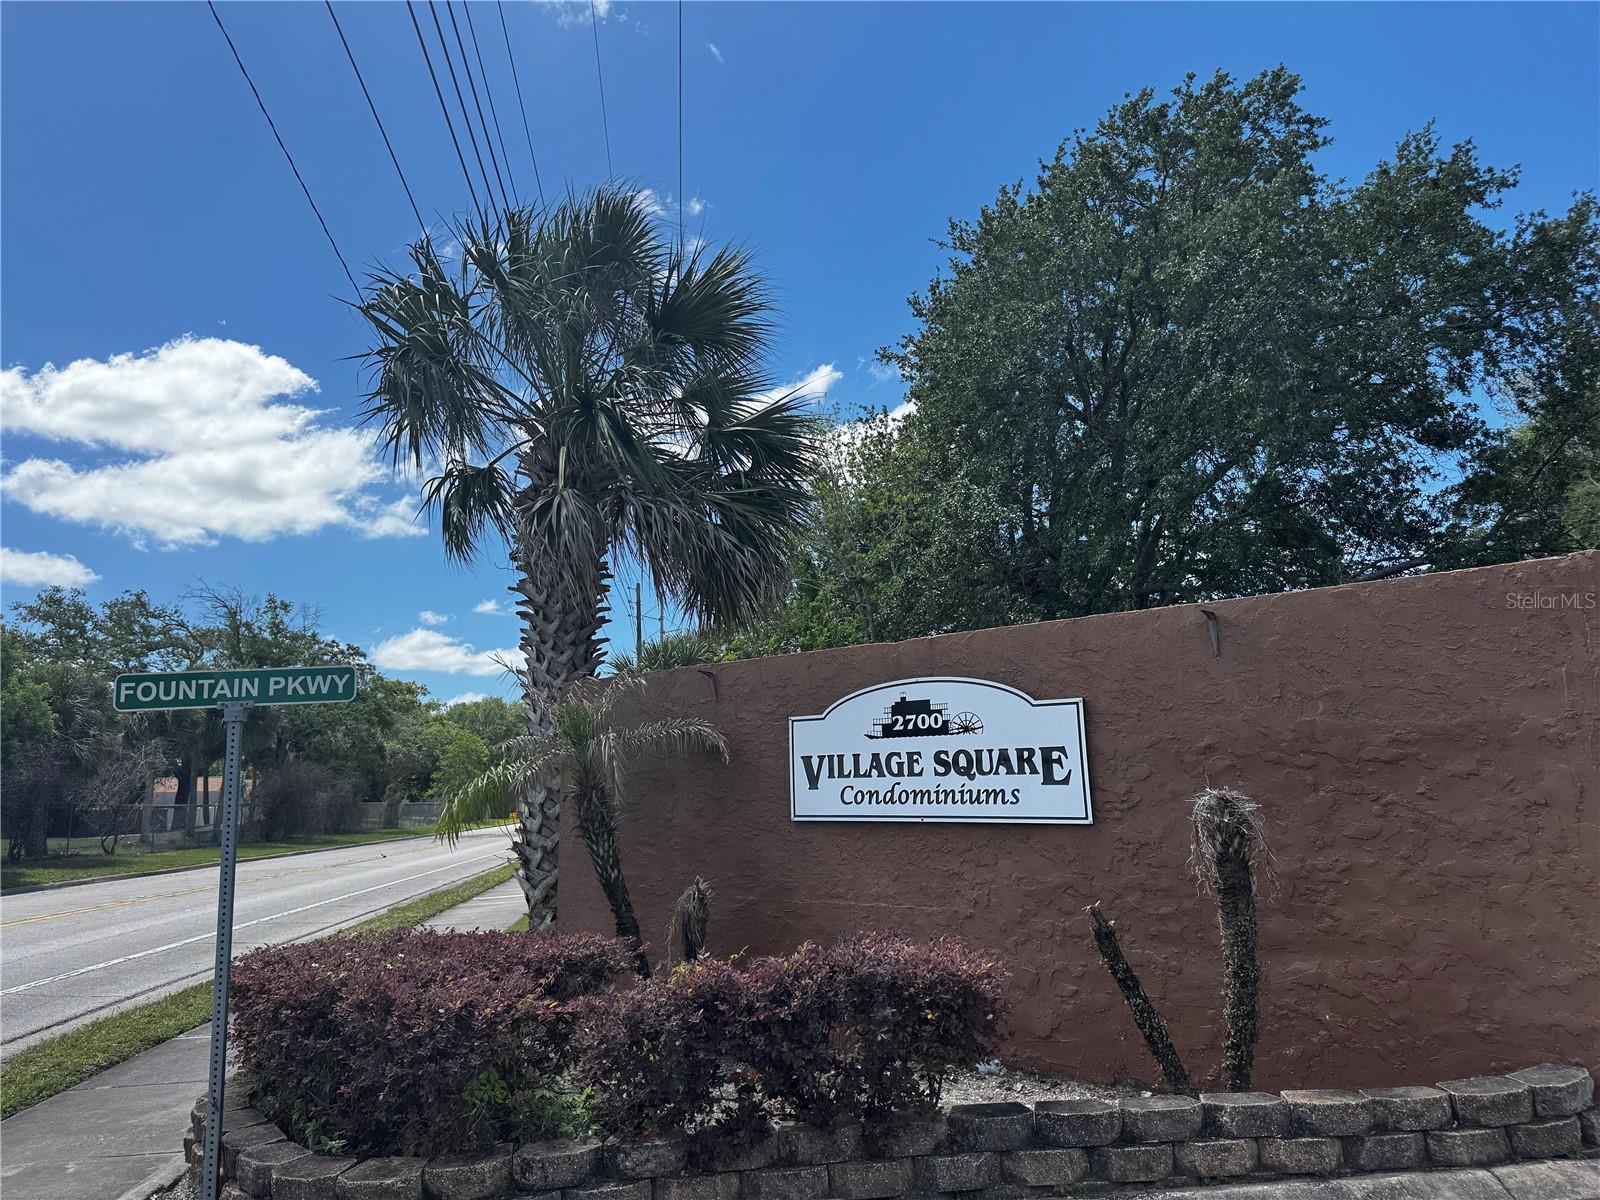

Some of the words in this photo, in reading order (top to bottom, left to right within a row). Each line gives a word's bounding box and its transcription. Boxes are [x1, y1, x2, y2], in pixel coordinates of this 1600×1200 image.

[119, 677, 259, 703] FOUNTAIN
[268, 673, 350, 696] PKWY
[891, 712, 943, 731] 2700
[800, 751, 925, 790] VILLAGE
[932, 745, 1072, 786] SQUARE
[840, 782, 1020, 806] Condominiums
